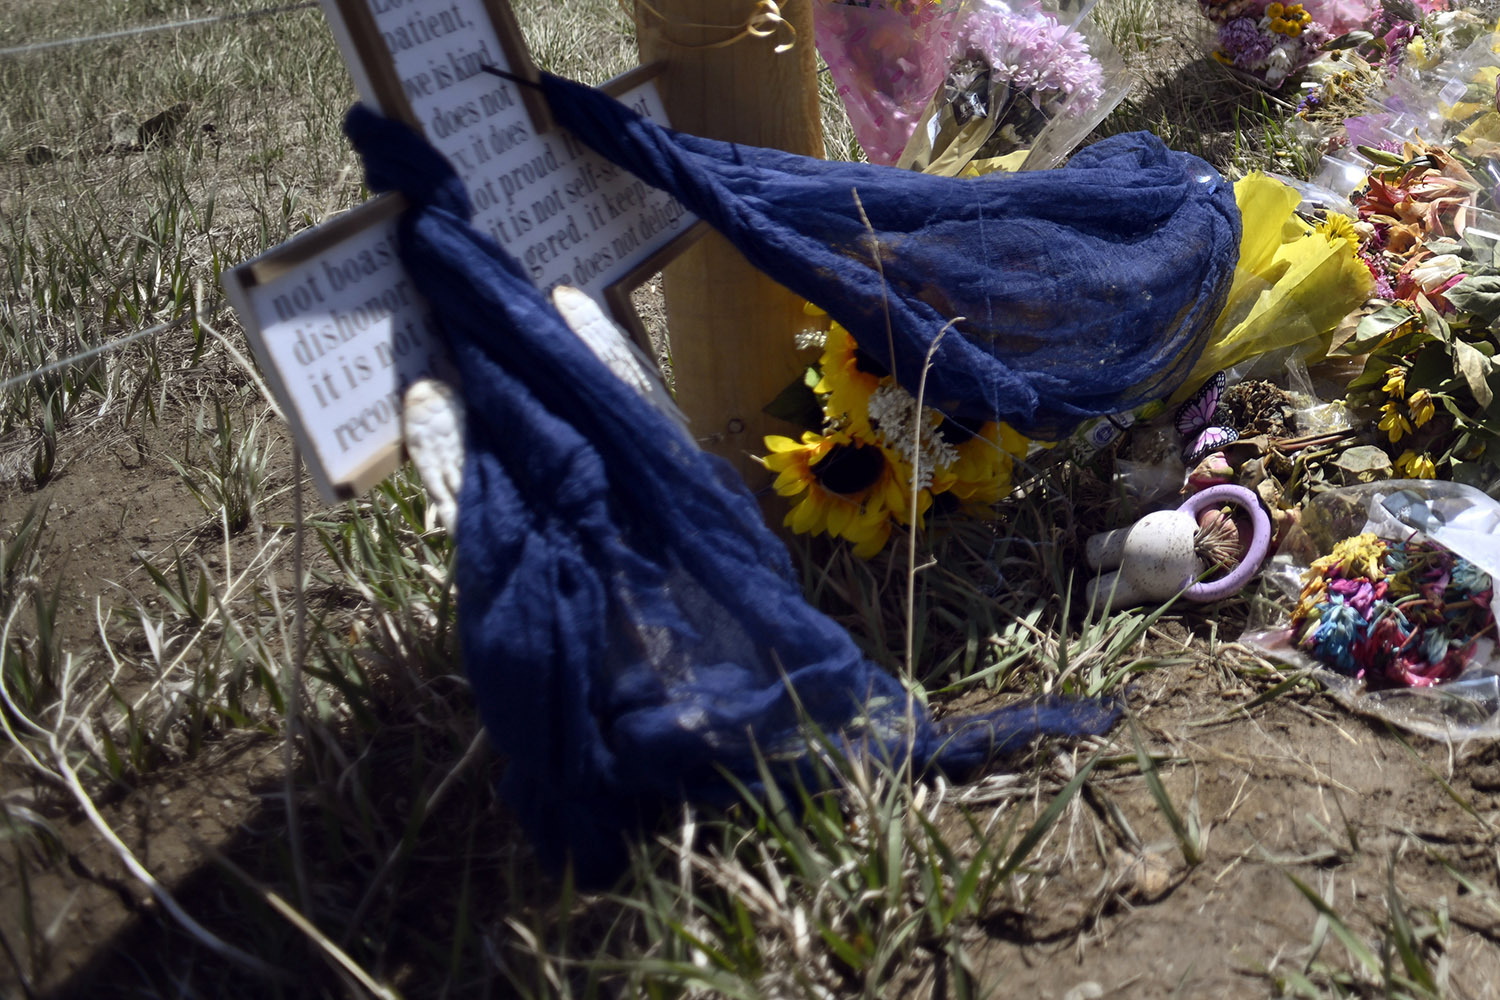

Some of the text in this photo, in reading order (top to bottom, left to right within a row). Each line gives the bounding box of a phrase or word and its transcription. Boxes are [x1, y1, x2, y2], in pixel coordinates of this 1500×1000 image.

[427, 60, 454, 90] is
[432, 84, 515, 139] does not
[488, 121, 529, 154] does
[272, 273, 325, 323] not
[472, 179, 499, 215] ot
[292, 280, 410, 367] dishonor
[489, 216, 512, 246] it
[506, 207, 532, 237] is
[531, 186, 567, 225] not
[574, 247, 615, 287] does
[611, 224, 641, 260] not
[639, 195, 686, 240] deligh
[306, 370, 341, 410] it
[338, 354, 374, 391] is
[374, 321, 423, 370] not
[584, 203, 606, 231] it
